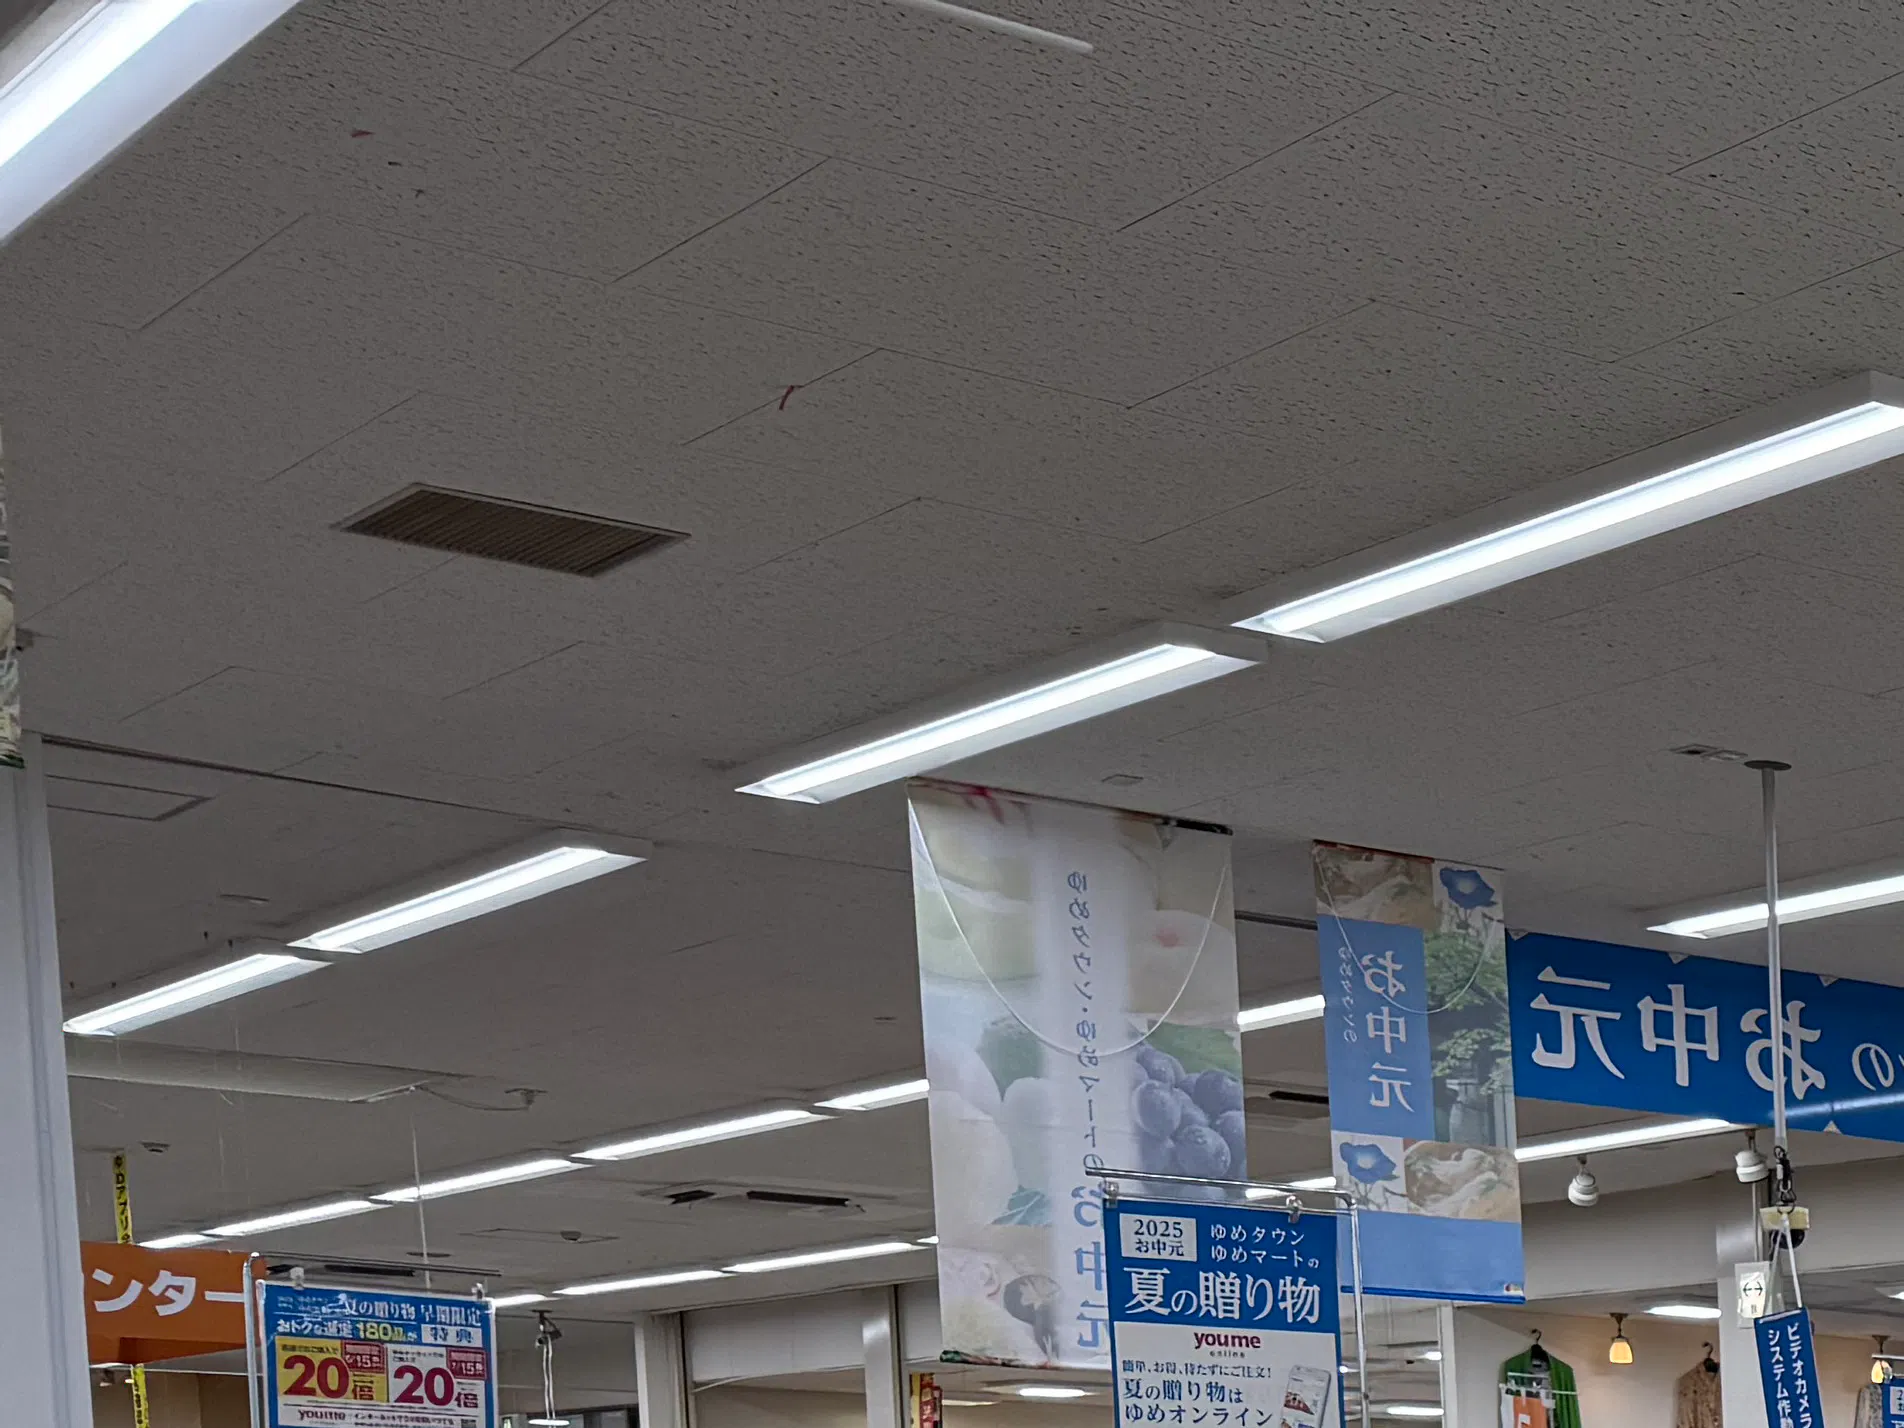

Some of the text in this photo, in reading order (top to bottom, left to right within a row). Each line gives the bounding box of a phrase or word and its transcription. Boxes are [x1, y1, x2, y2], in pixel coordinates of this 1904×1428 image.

[1134, 1219, 1183, 1239] 2025
[1211, 1223, 1305, 1246] ゆめタウン
[1135, 1238, 1185, 1257] お中元
[1211, 1246, 1320, 1269] ゆめマートの
[1123, 1266, 1321, 1324] 夏の贈り物
[1194, 1331, 1261, 1350] youme
[283, 1355, 350, 1399] 20
[352, 1384, 375, 1401] 倍
[393, 1365, 479, 1408] 20 倍
[1123, 1378, 1244, 1404] 夏の贈り物は
[1125, 1407, 1274, 1427] ゆめオンライン
